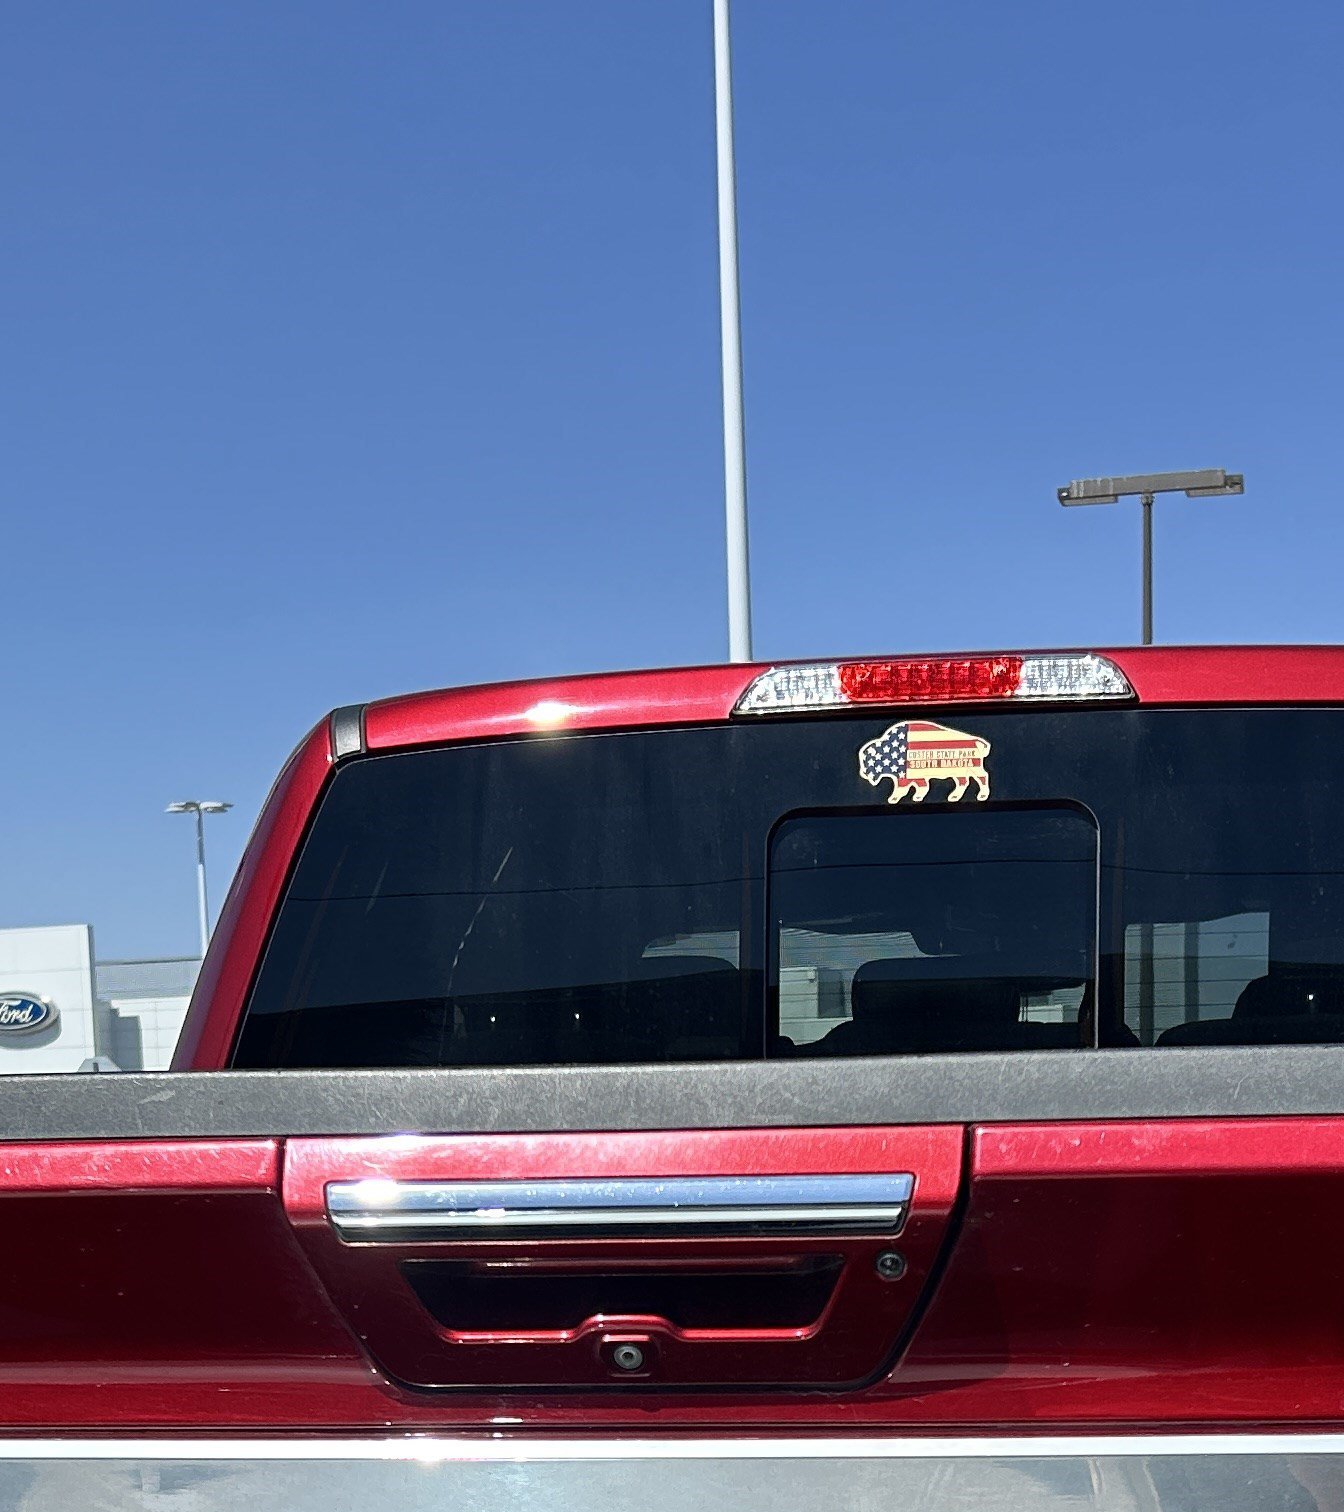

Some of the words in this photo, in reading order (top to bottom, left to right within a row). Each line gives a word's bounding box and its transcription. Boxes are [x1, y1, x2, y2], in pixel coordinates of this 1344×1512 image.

[958, 750, 976, 758] PARK
[908, 760, 938, 769] SOUTH
[940, 759, 974, 768] DAKOTA
